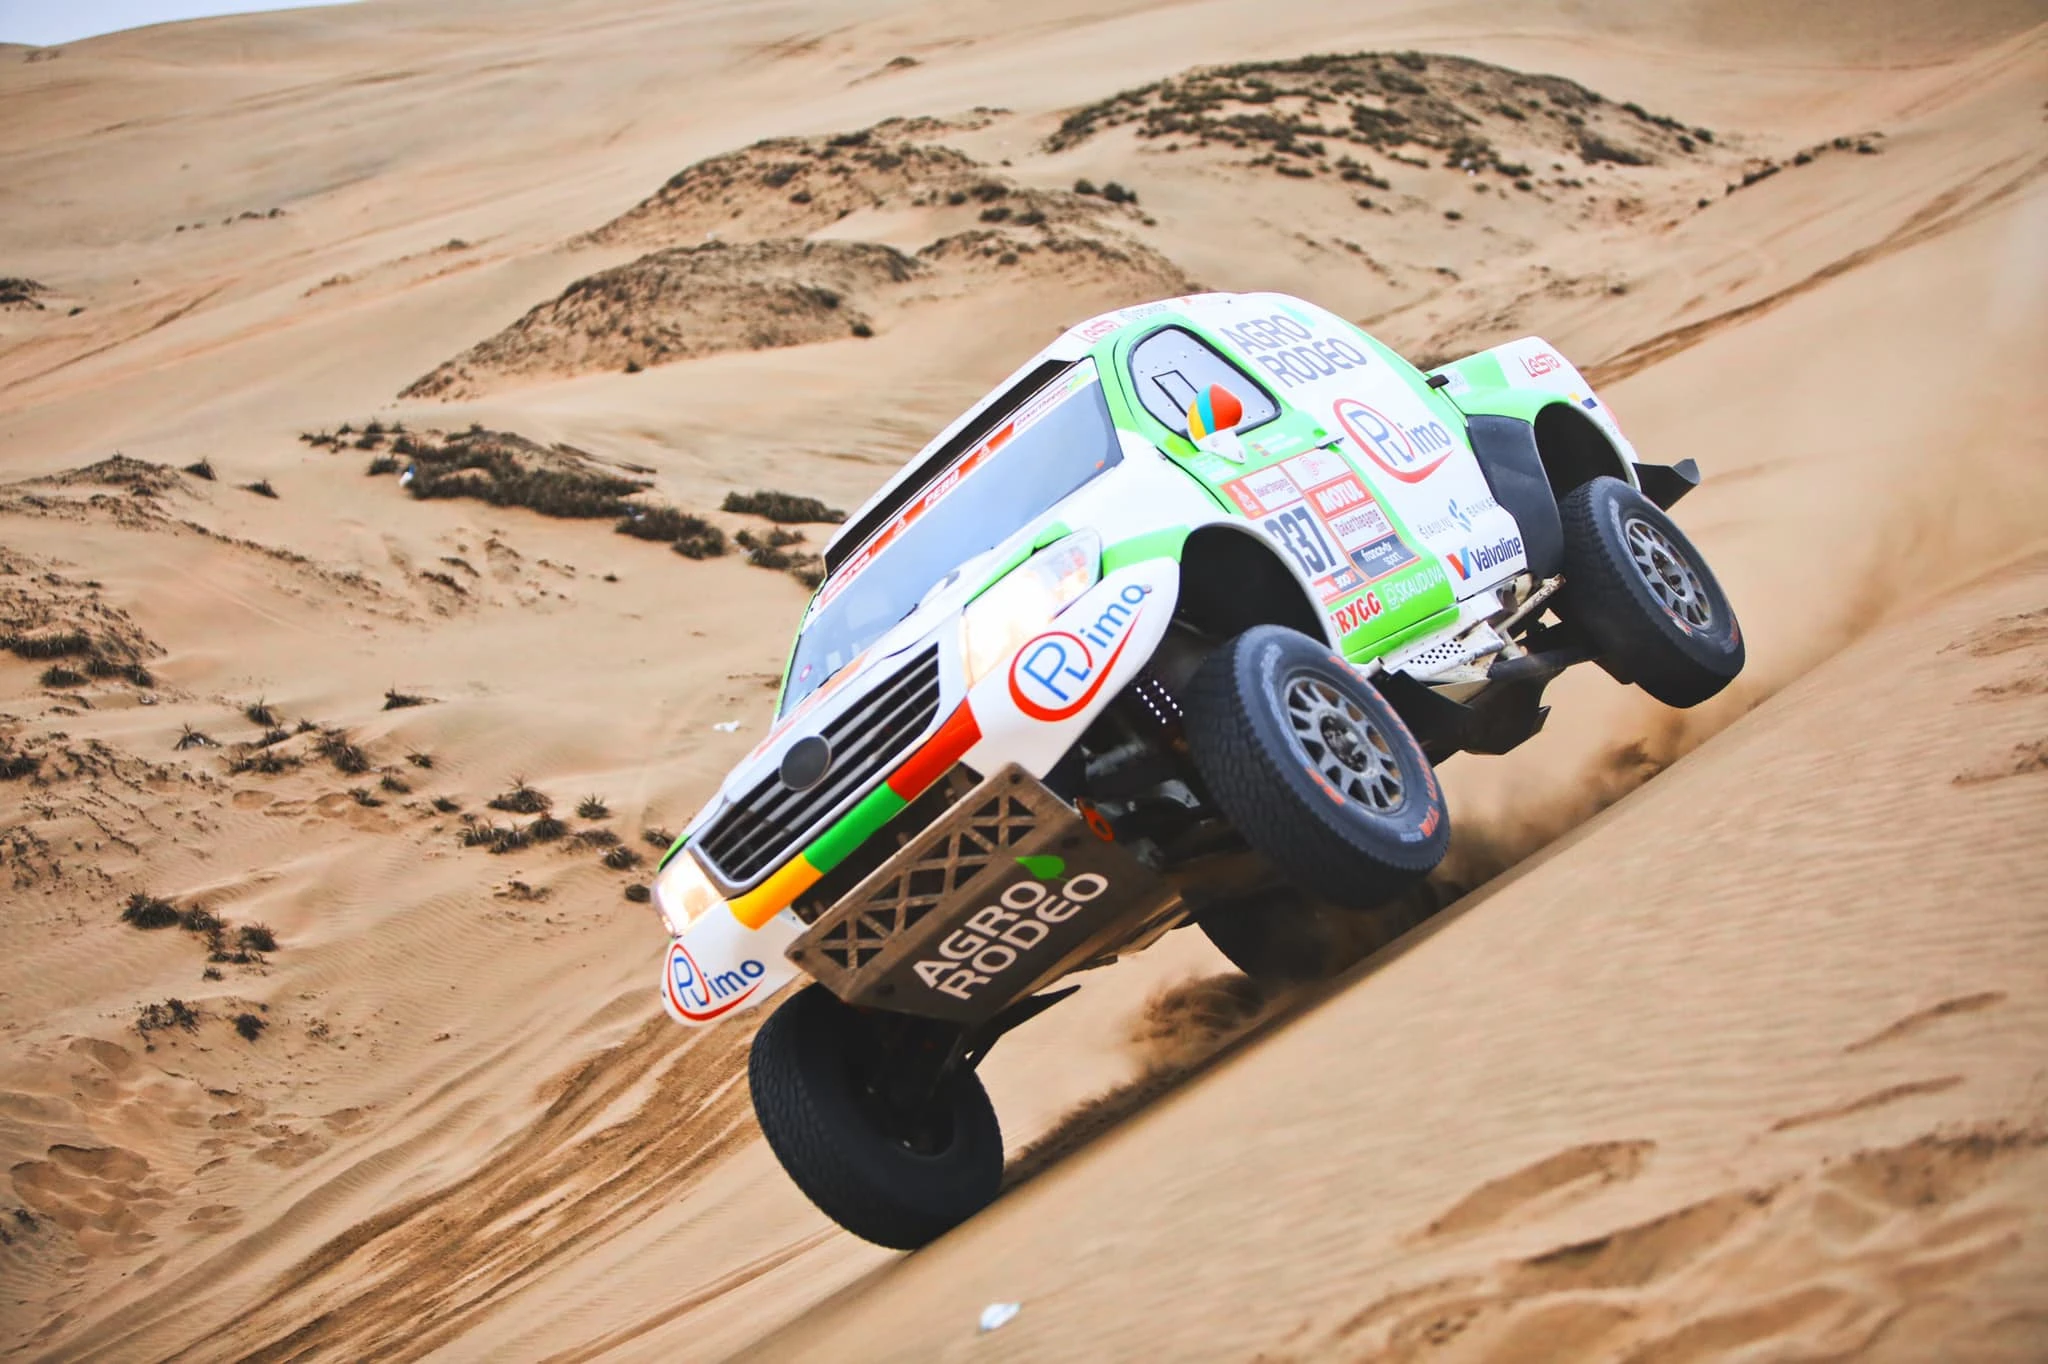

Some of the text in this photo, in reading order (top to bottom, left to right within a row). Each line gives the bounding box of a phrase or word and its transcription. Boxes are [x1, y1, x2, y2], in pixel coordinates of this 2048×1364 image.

[1219, 314, 1313, 356] AGRO
[1256, 338, 1368, 389] RODEO
[1315, 480, 1366, 514] MOTUL
[1263, 506, 1337, 578] 337
[1469, 536, 1523, 572] Valvoline
[913, 880, 1047, 989] AGRO
[936, 873, 1109, 1000] RODEO
